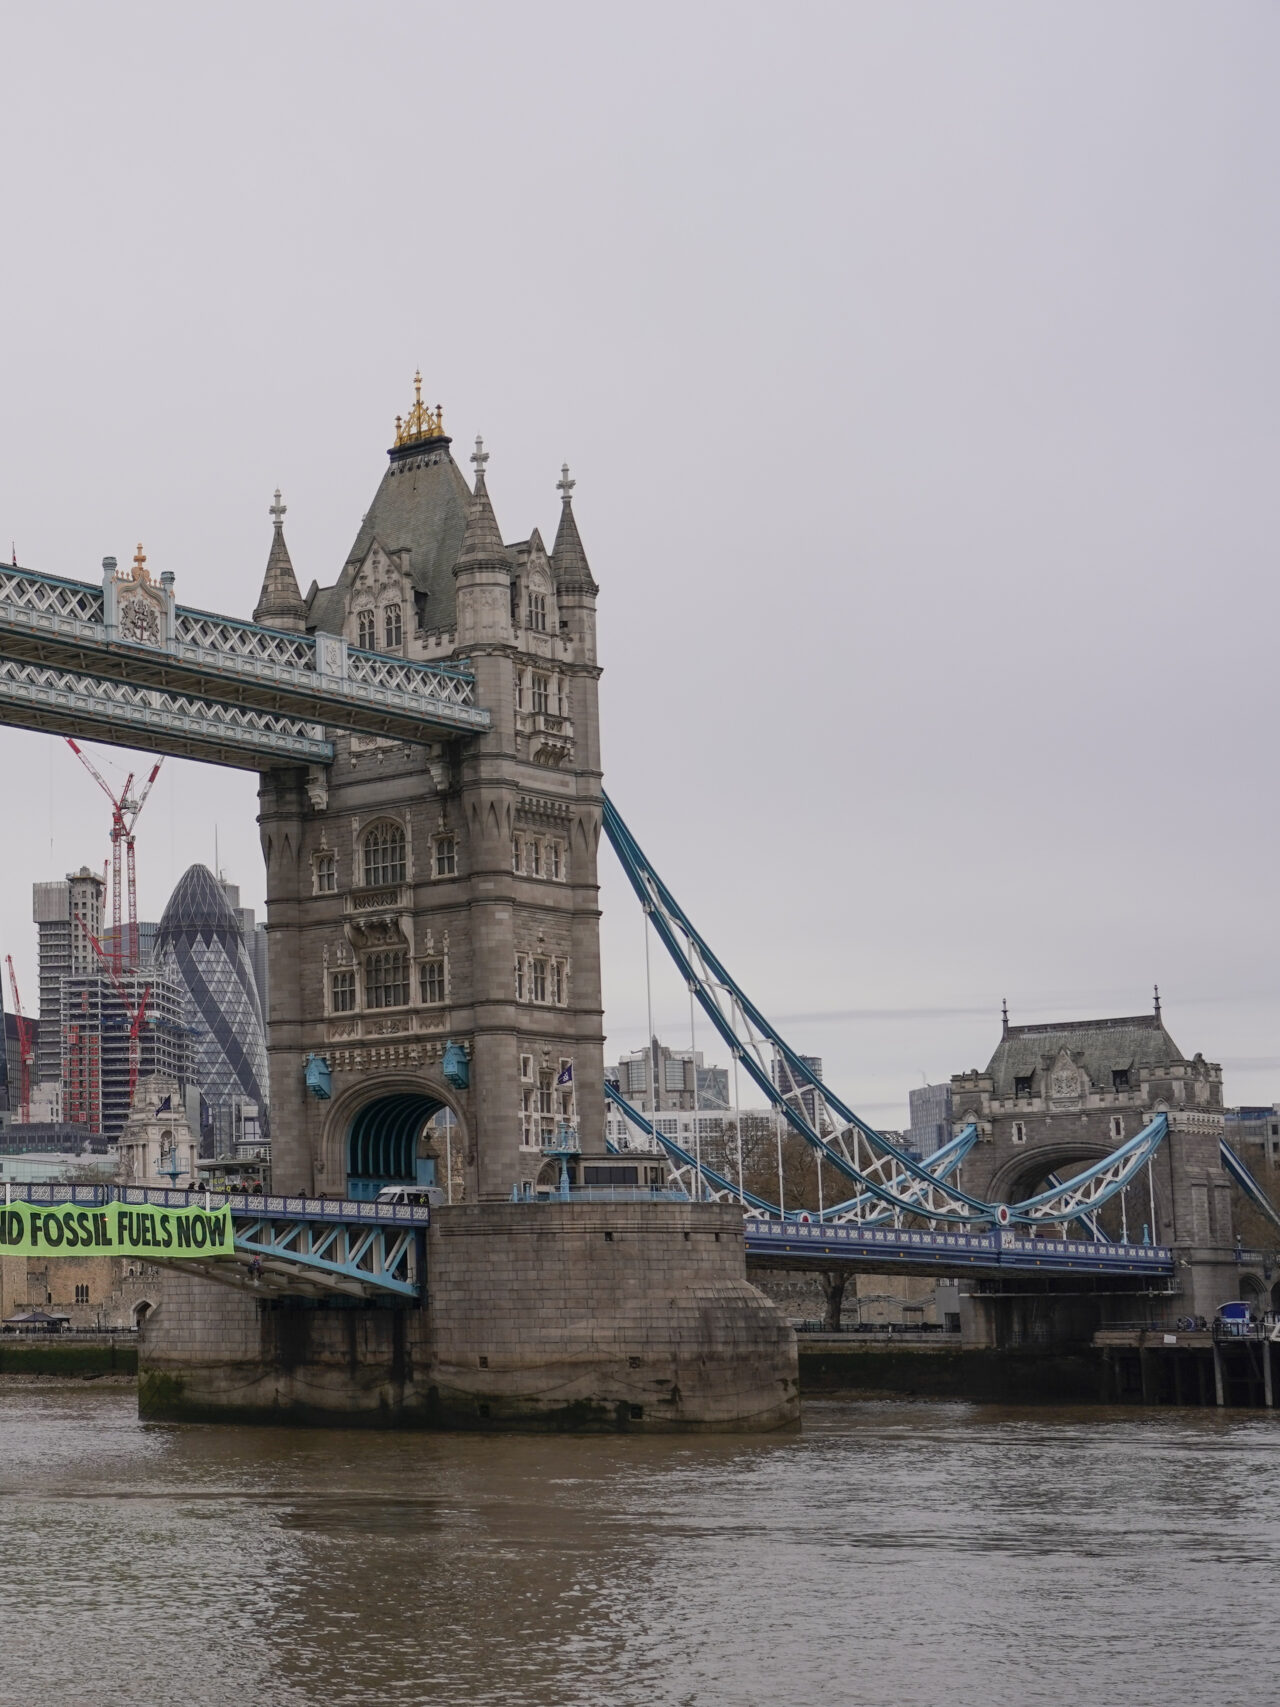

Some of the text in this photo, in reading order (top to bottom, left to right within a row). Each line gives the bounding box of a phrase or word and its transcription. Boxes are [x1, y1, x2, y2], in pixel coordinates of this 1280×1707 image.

[30, 1212, 112, 1248] FOSSIL
[118, 1210, 173, 1248] FUELS
[176, 1213, 227, 1248] NOW
